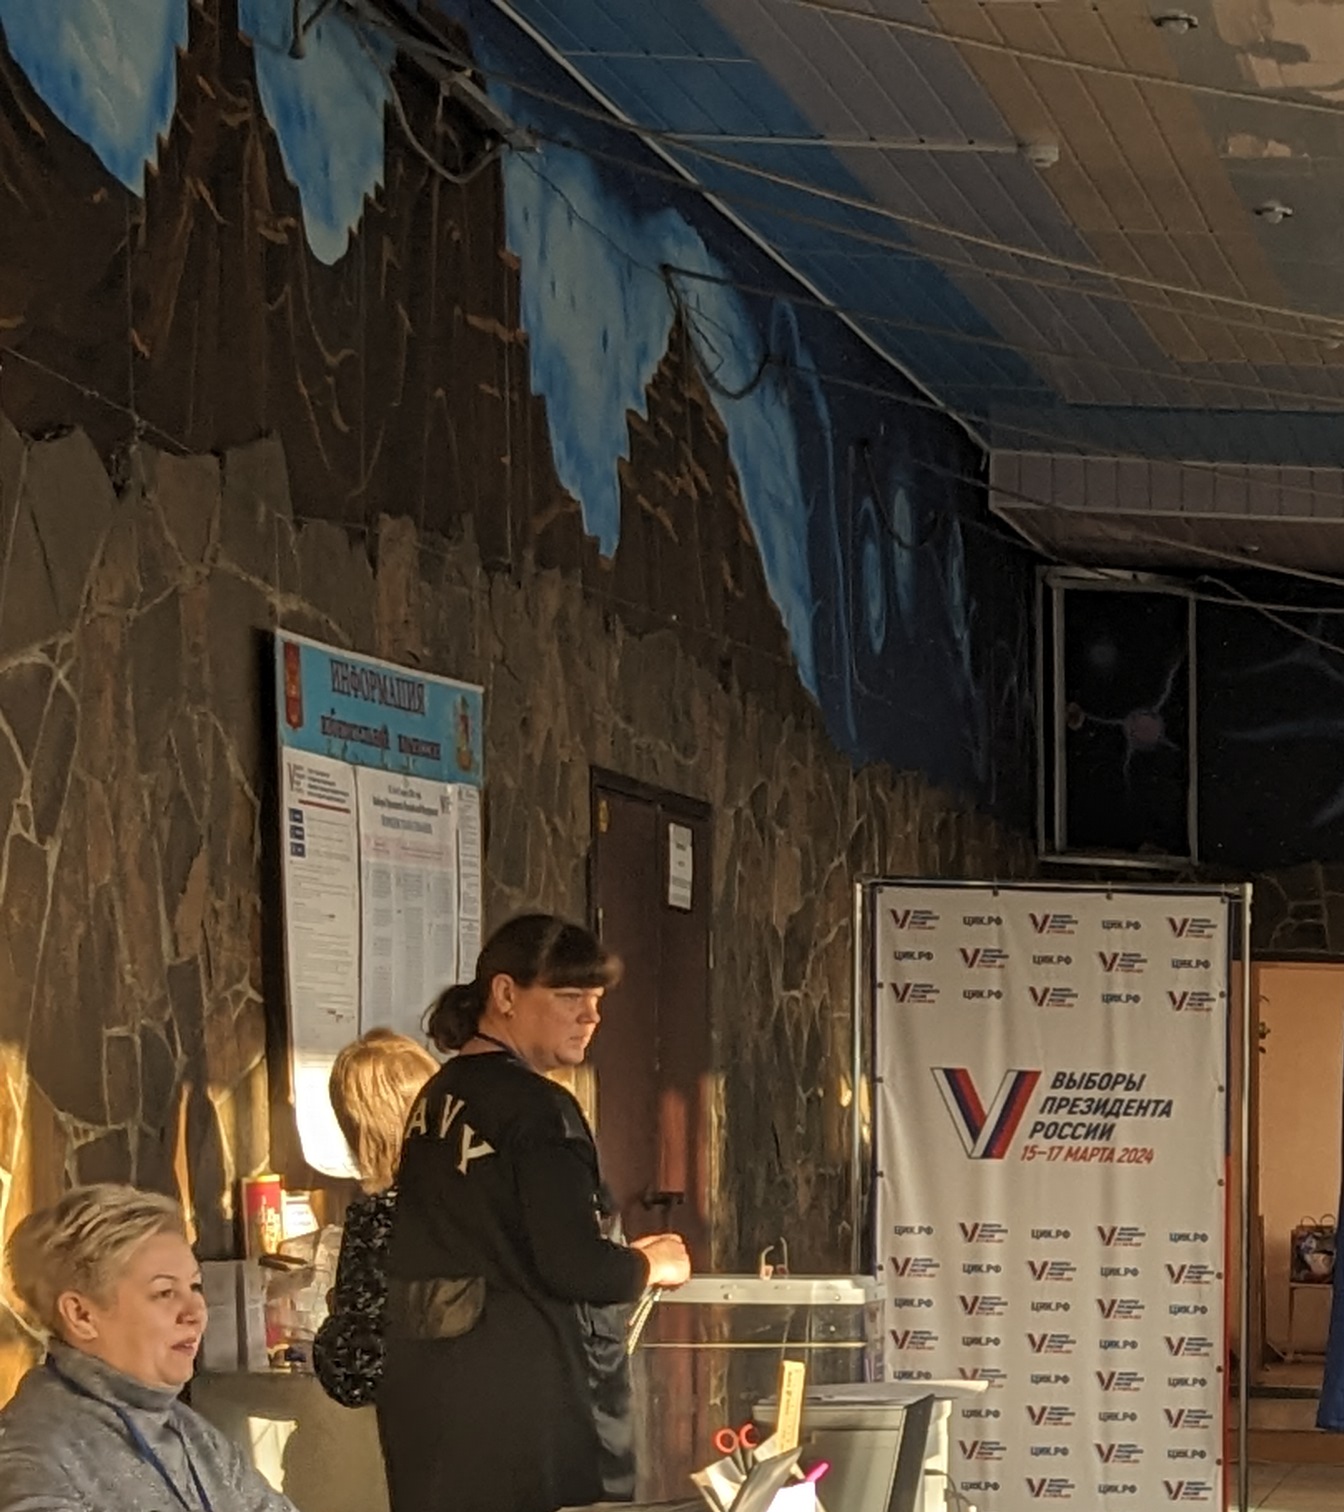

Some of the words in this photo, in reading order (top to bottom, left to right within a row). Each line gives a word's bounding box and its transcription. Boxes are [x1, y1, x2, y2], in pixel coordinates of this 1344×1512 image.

[1050, 1071, 1147, 1092] ВЫБОРЫ
[1039, 1096, 1173, 1119] ПРЕЗИДЕНТА
[1028, 1121, 1117, 1141] РОССИИ
[1064, 1145, 1115, 1163] МАРТА
[1119, 1146, 1154, 1164] 2024
